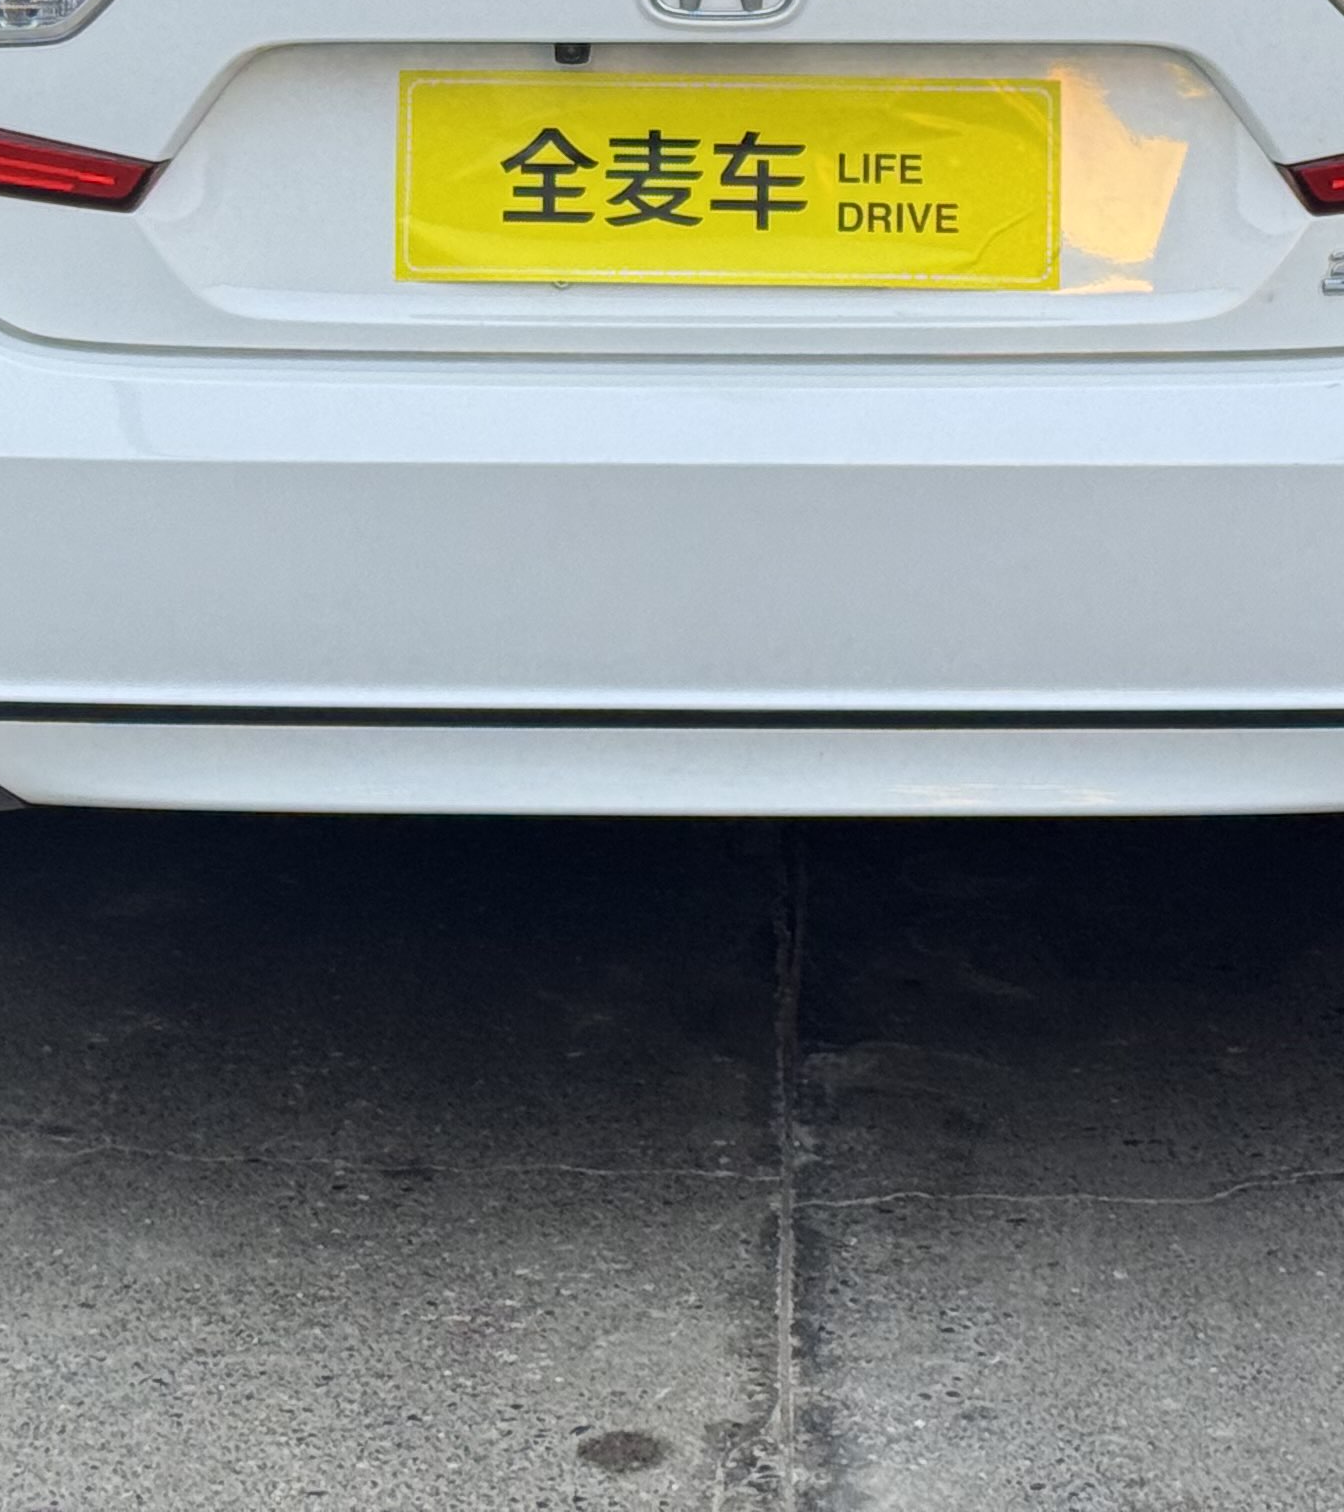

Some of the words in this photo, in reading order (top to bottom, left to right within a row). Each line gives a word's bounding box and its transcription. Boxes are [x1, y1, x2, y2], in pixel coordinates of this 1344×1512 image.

[500, 128, 808, 230] 全麦车
[838, 152, 923, 184] LIFE
[837, 202, 959, 234] DRIVE
